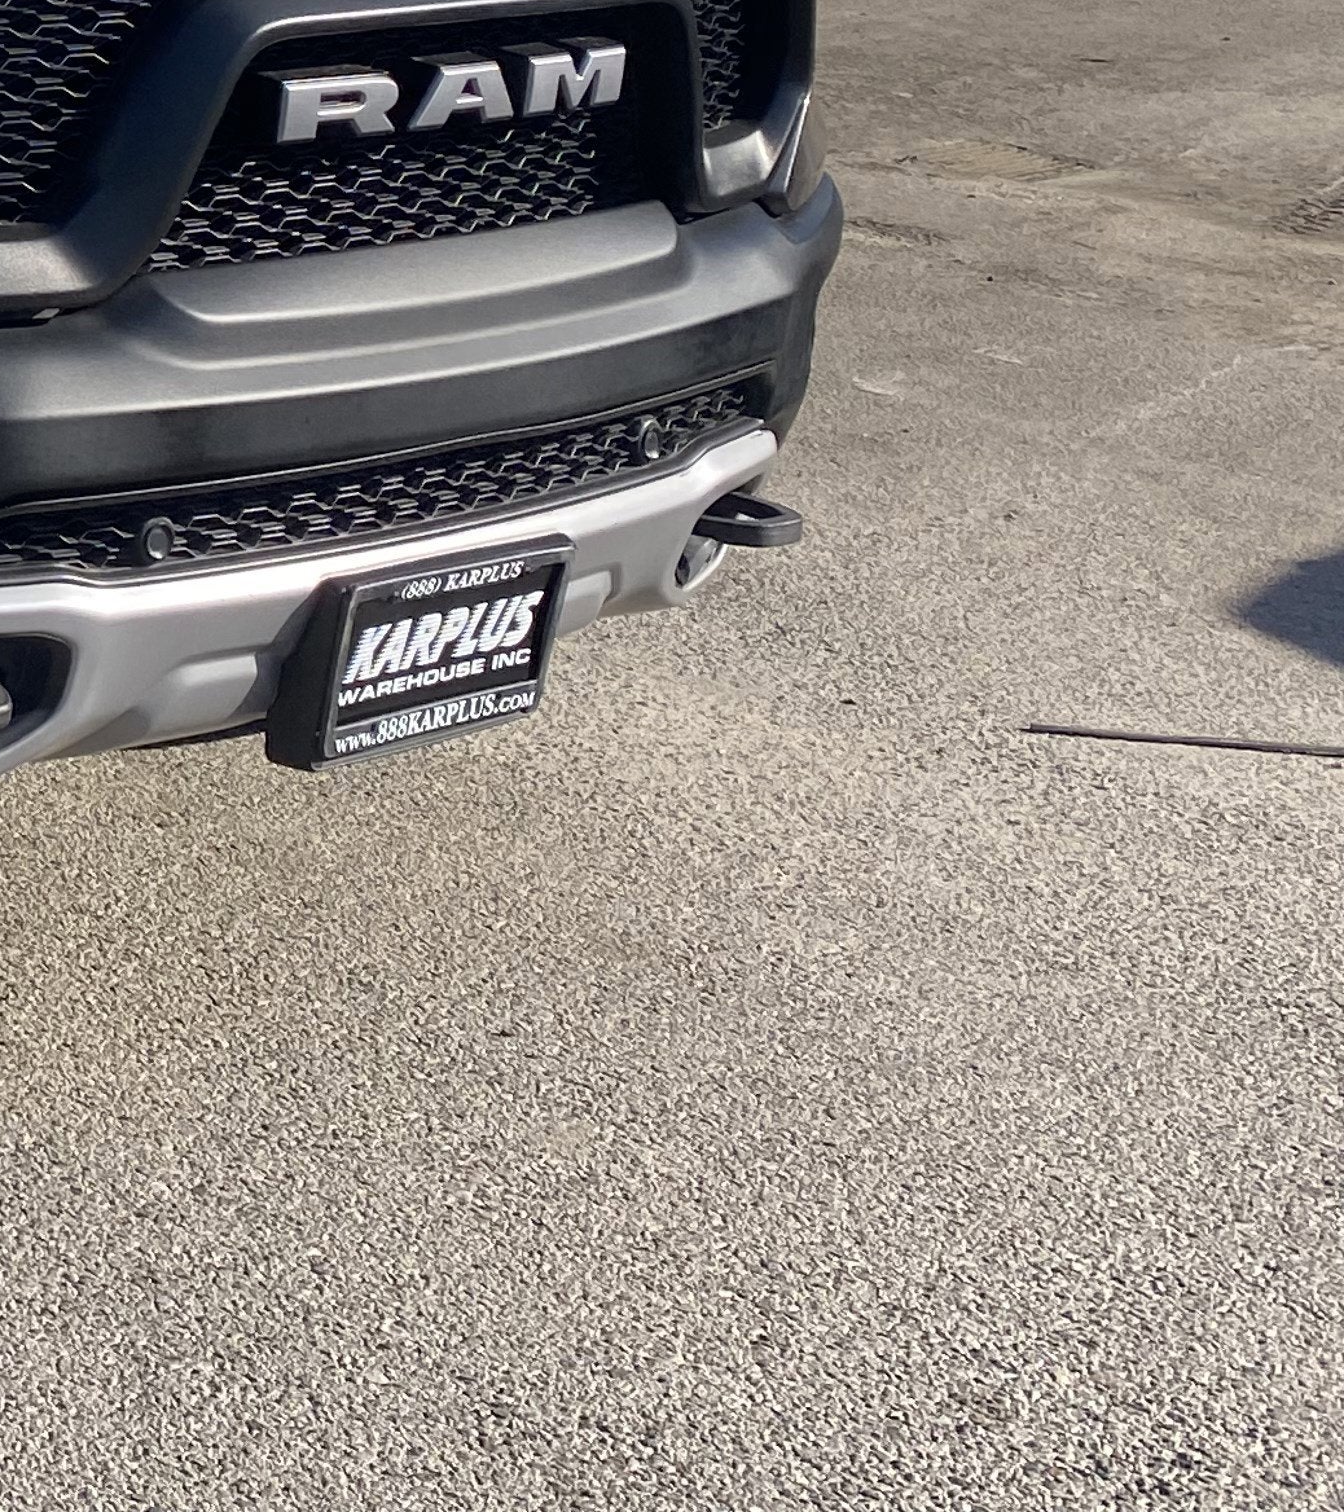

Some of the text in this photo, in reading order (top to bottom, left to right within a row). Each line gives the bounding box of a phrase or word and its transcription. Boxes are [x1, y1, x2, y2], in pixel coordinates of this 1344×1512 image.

[275, 40, 627, 144] RAM
[400, 560, 525, 601] (888) KARPLUS
[342, 589, 545, 685] KARPLUS
[337, 647, 532, 707] WAREHOUSE INC
